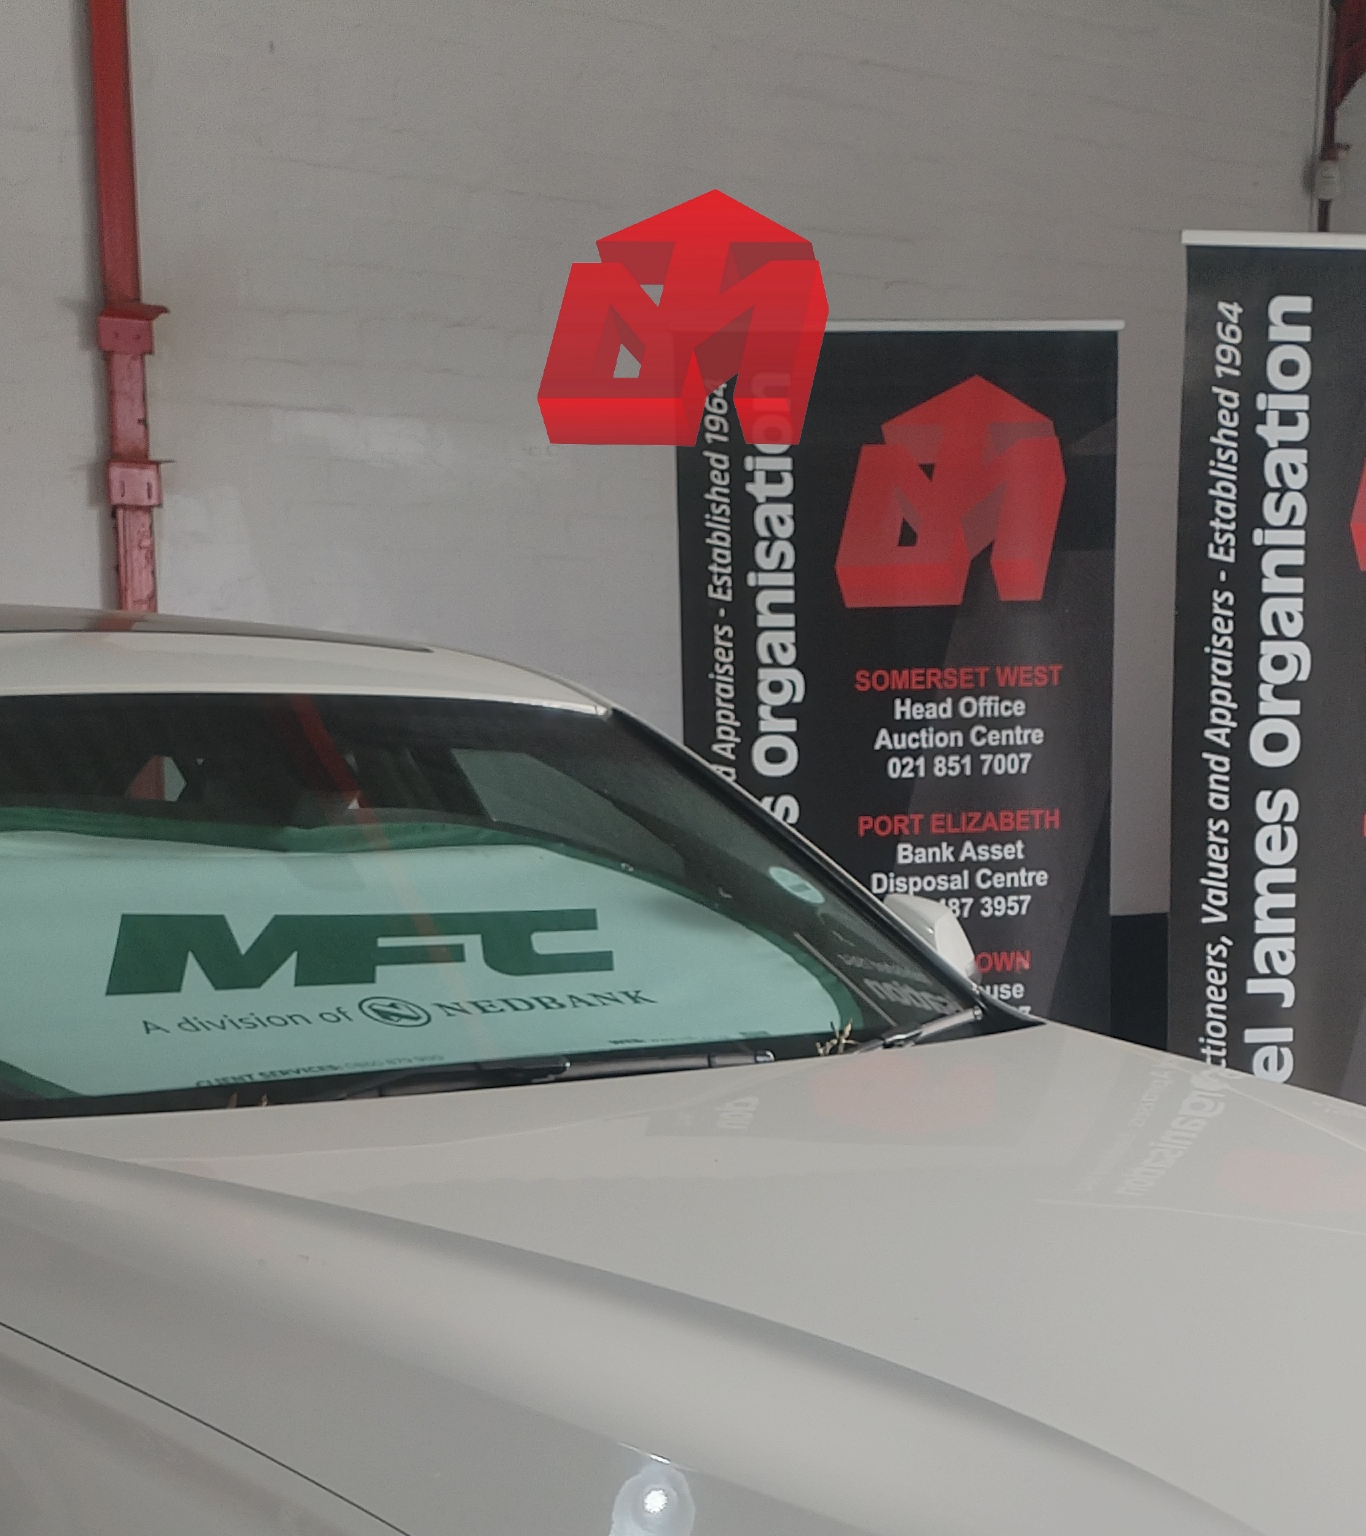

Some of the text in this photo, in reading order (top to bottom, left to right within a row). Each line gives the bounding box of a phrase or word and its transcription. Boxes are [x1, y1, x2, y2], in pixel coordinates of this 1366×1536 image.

[1214, 300, 1243, 378] 1964
[1208, 386, 1240, 564] Established
[702, 450, 733, 602] Established
[1249, 295, 1312, 768] Organisation
[708, 623, 741, 760] Appraisers
[854, 664, 1063, 691] SOMERSET WEST
[1203, 590, 1238, 748] Appraisers
[894, 695, 1026, 720] Head Office
[874, 724, 1045, 750] Auction Centre
[887, 752, 1032, 779] 021 851 7007
[1202, 752, 1231, 811] and
[857, 807, 1060, 837] PORT ELIZABETH
[897, 839, 1025, 864] Bank Asset
[1200, 818, 1230, 923] Valuers
[871, 866, 1049, 896] Disposal Centre
[1246, 788, 1300, 1008] James
[980, 894, 1031, 918] 3957
[105, 908, 614, 996] MFC
[975, 950, 1031, 974] OWN
[142, 989, 659, 1035] A division of NEDBANK
[978, 983, 1025, 1000] use
